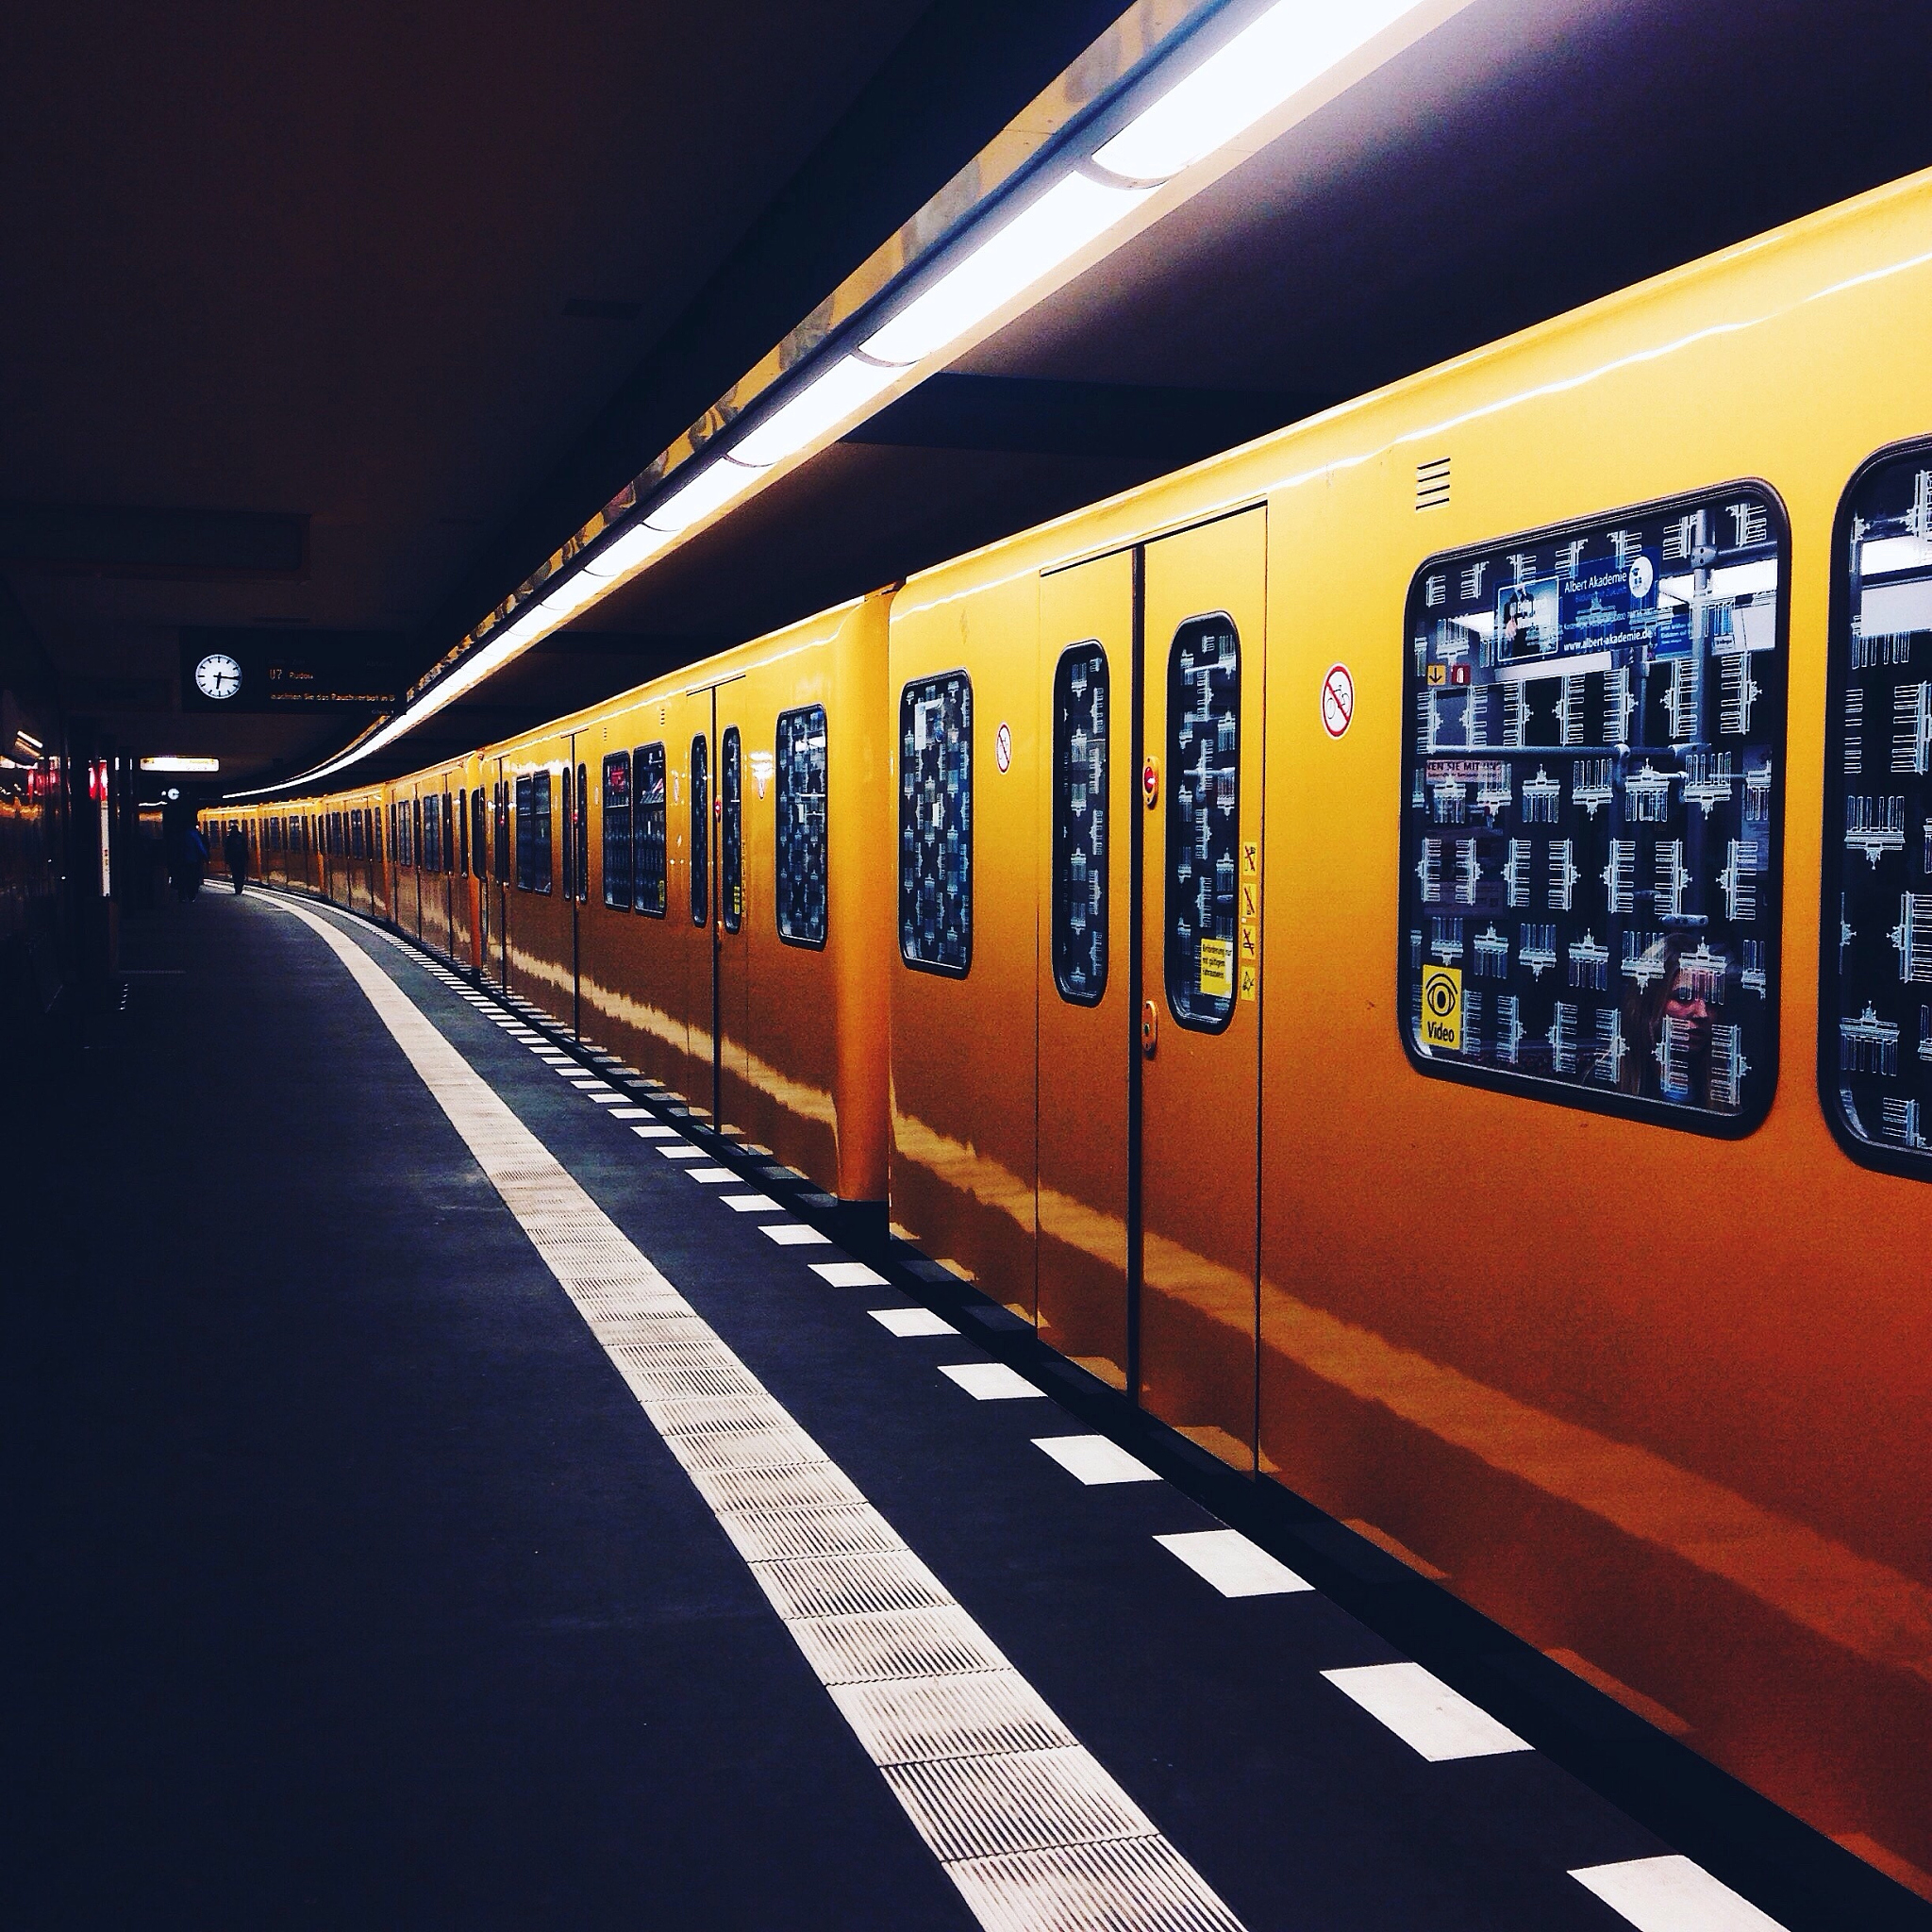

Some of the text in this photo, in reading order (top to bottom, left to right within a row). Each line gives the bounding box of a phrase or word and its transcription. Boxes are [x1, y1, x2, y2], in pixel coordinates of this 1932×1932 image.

[1564, 570, 1627, 593] Albert Akademie
[1563, 629, 1653, 651] www.albert-akademie.de
[1447, 761, 1460, 771] SIE
[1464, 761, 1480, 771] MIT
[1427, 1021, 1455, 1043] Video
